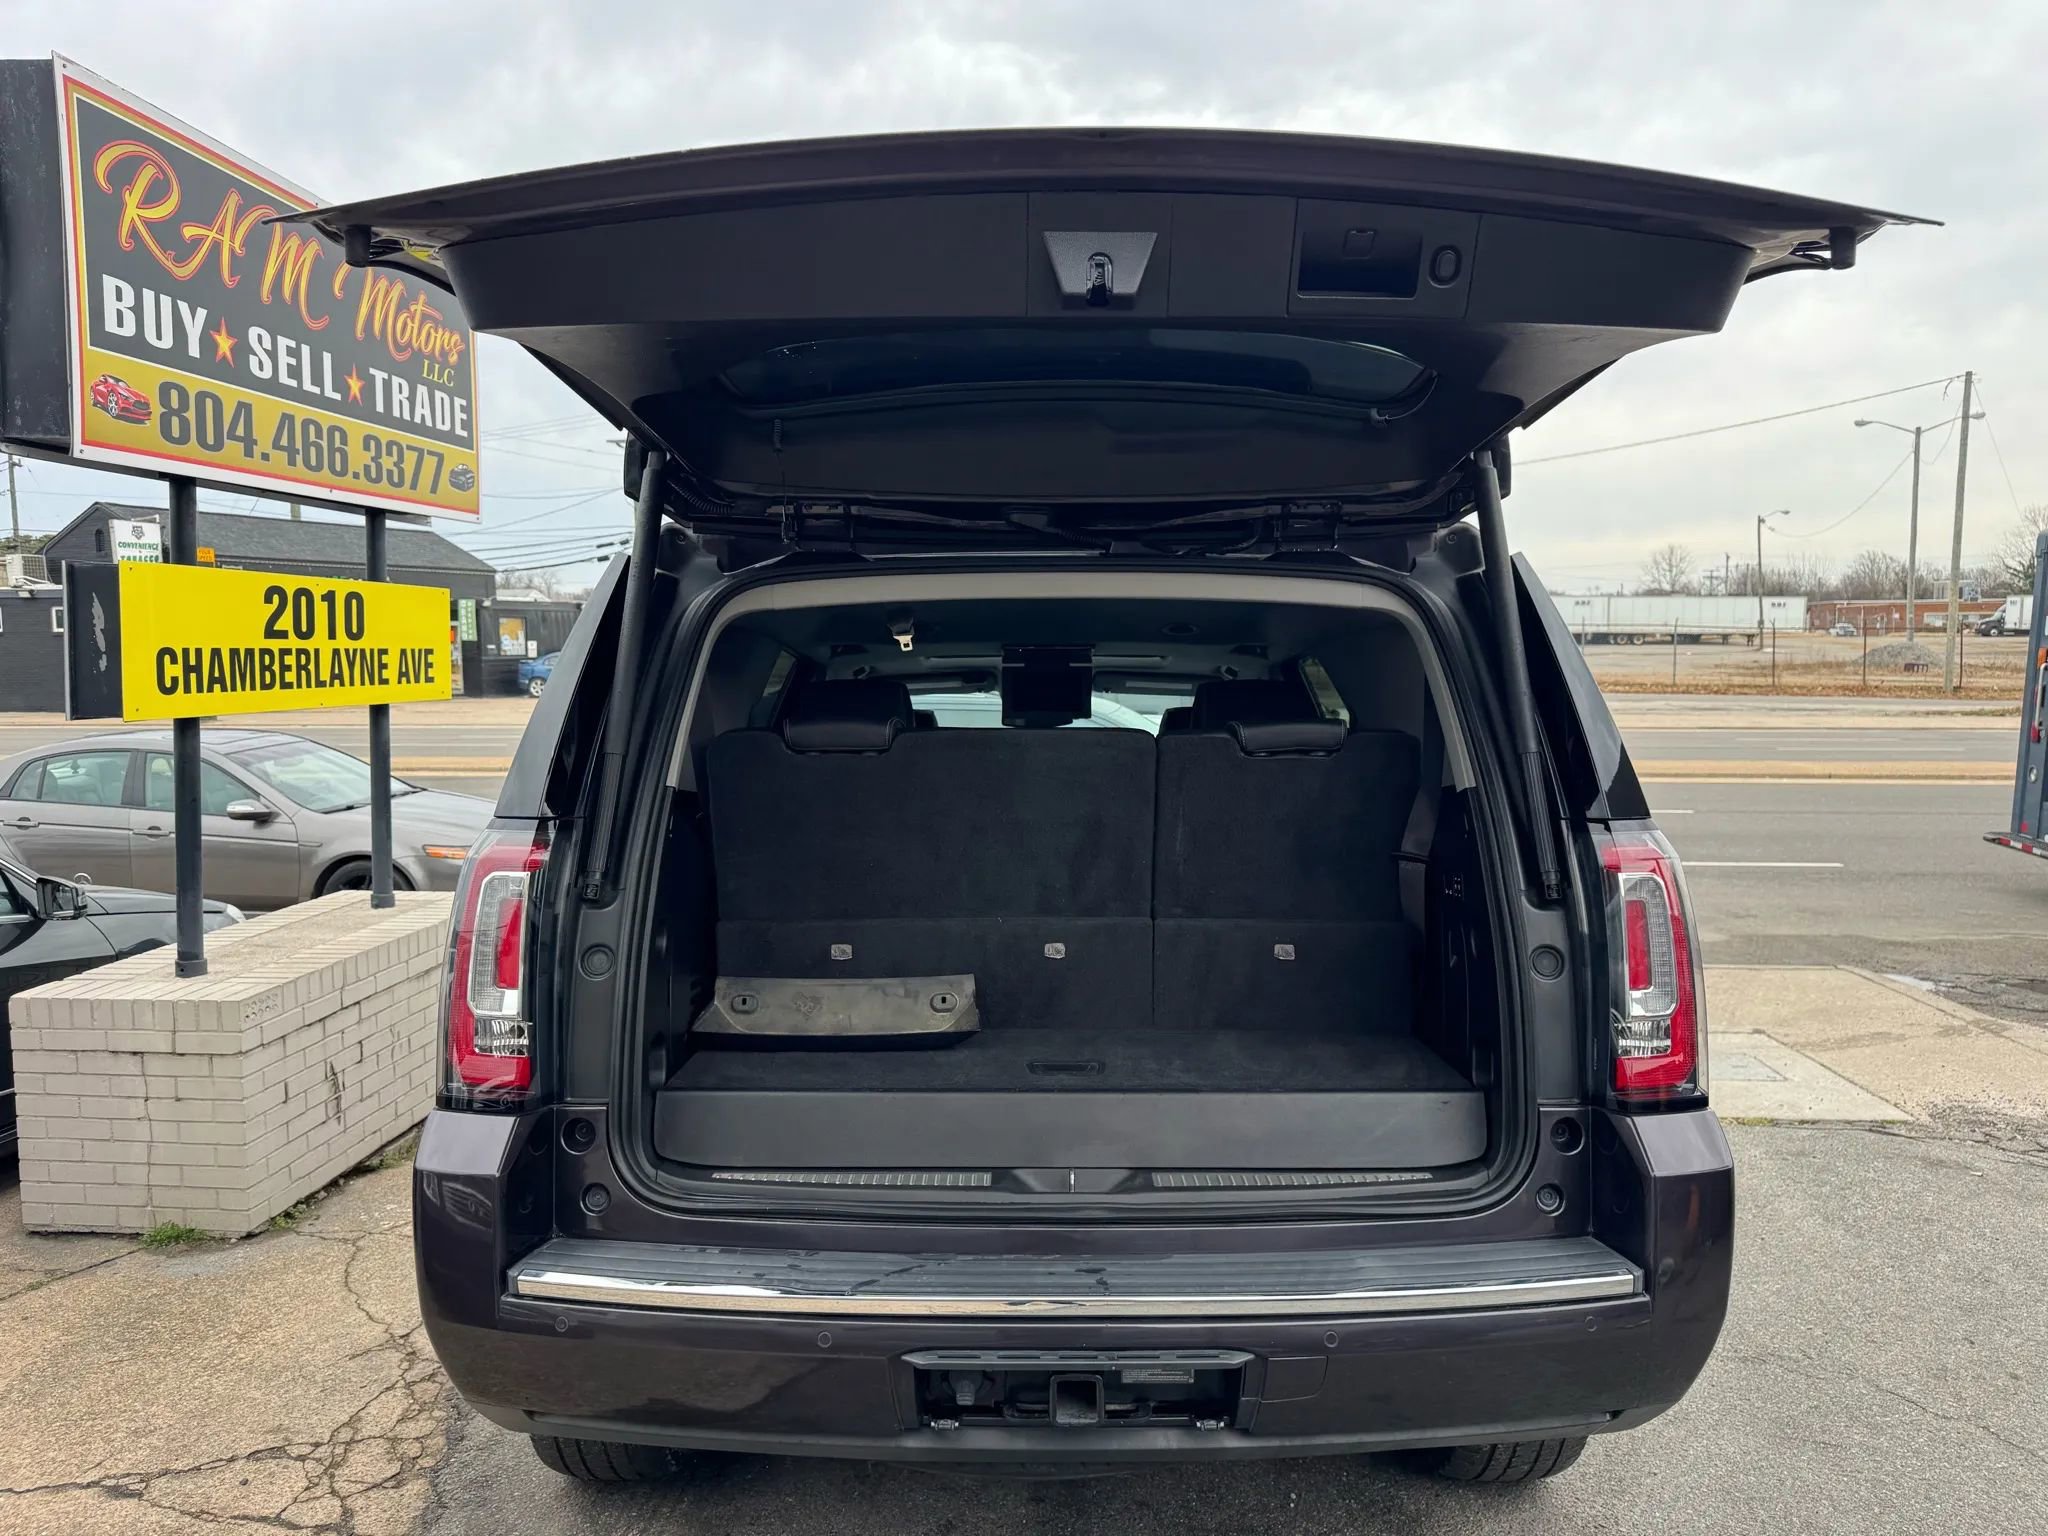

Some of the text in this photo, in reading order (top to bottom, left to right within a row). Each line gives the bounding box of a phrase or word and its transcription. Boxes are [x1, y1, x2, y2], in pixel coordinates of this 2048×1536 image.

[333, 261, 465, 366] Motors
[102, 273, 468, 438] BUY SELL TRADE
[423, 360, 455, 388] LLC
[158, 381, 445, 495] 804.466.3377
[118, 541, 159, 551] CONVENIENCE
[263, 585, 365, 641] 2010
[155, 646, 435, 696] CHAMBERLAYNE AVE
